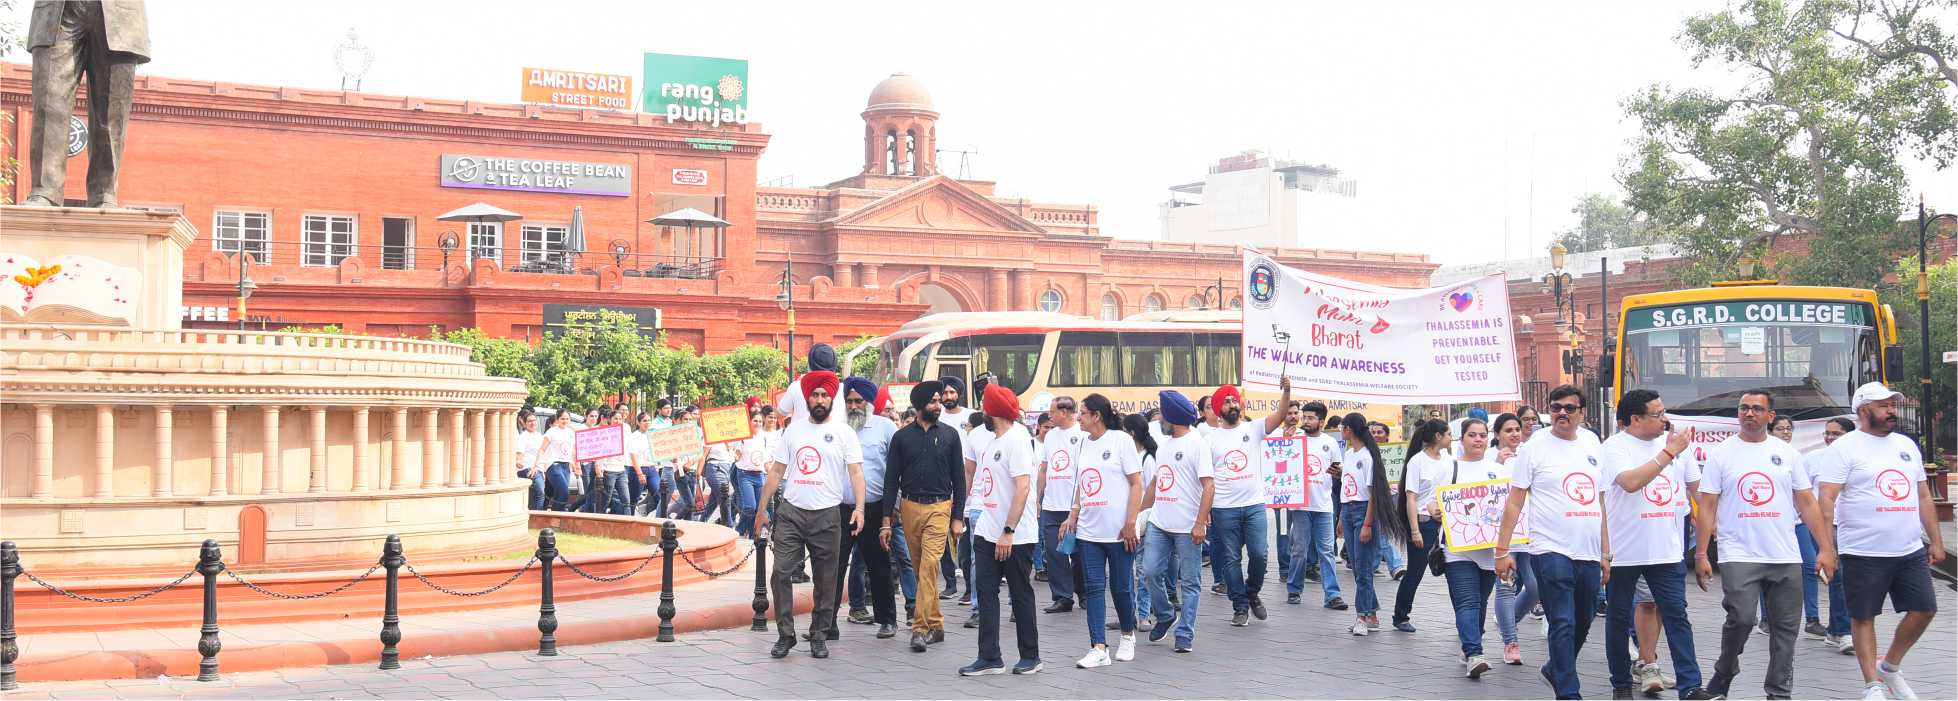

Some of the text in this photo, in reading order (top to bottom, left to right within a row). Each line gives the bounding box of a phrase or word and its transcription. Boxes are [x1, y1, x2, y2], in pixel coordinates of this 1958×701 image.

[552, 92, 626, 108] STREET FOOD
[661, 82, 714, 105] rang
[667, 100, 748, 127] punjab
[484, 158, 627, 178] THE COFFEE BEAN
[500, 172, 531, 186] TEA
[536, 175, 575, 188] LEAF
[180, 306, 229, 321] FFEE
[1652, 303, 1846, 327] S.G.R.D. COLLEGE
[1426, 317, 1503, 331] THALASSEMIA IS
[1311, 323, 1364, 350] Bharat
[1248, 345, 1406, 374] THE WALK FOR AWARENESS
[1434, 352, 1502, 364] GET YOURSELF
[1454, 370, 1488, 381] TESTED
[1112, 401, 1136, 412] RAM
[1139, 401, 1159, 412] DAS
[1273, 495, 1290, 504] DAY
[1460, 485, 1489, 499] BLOOD
